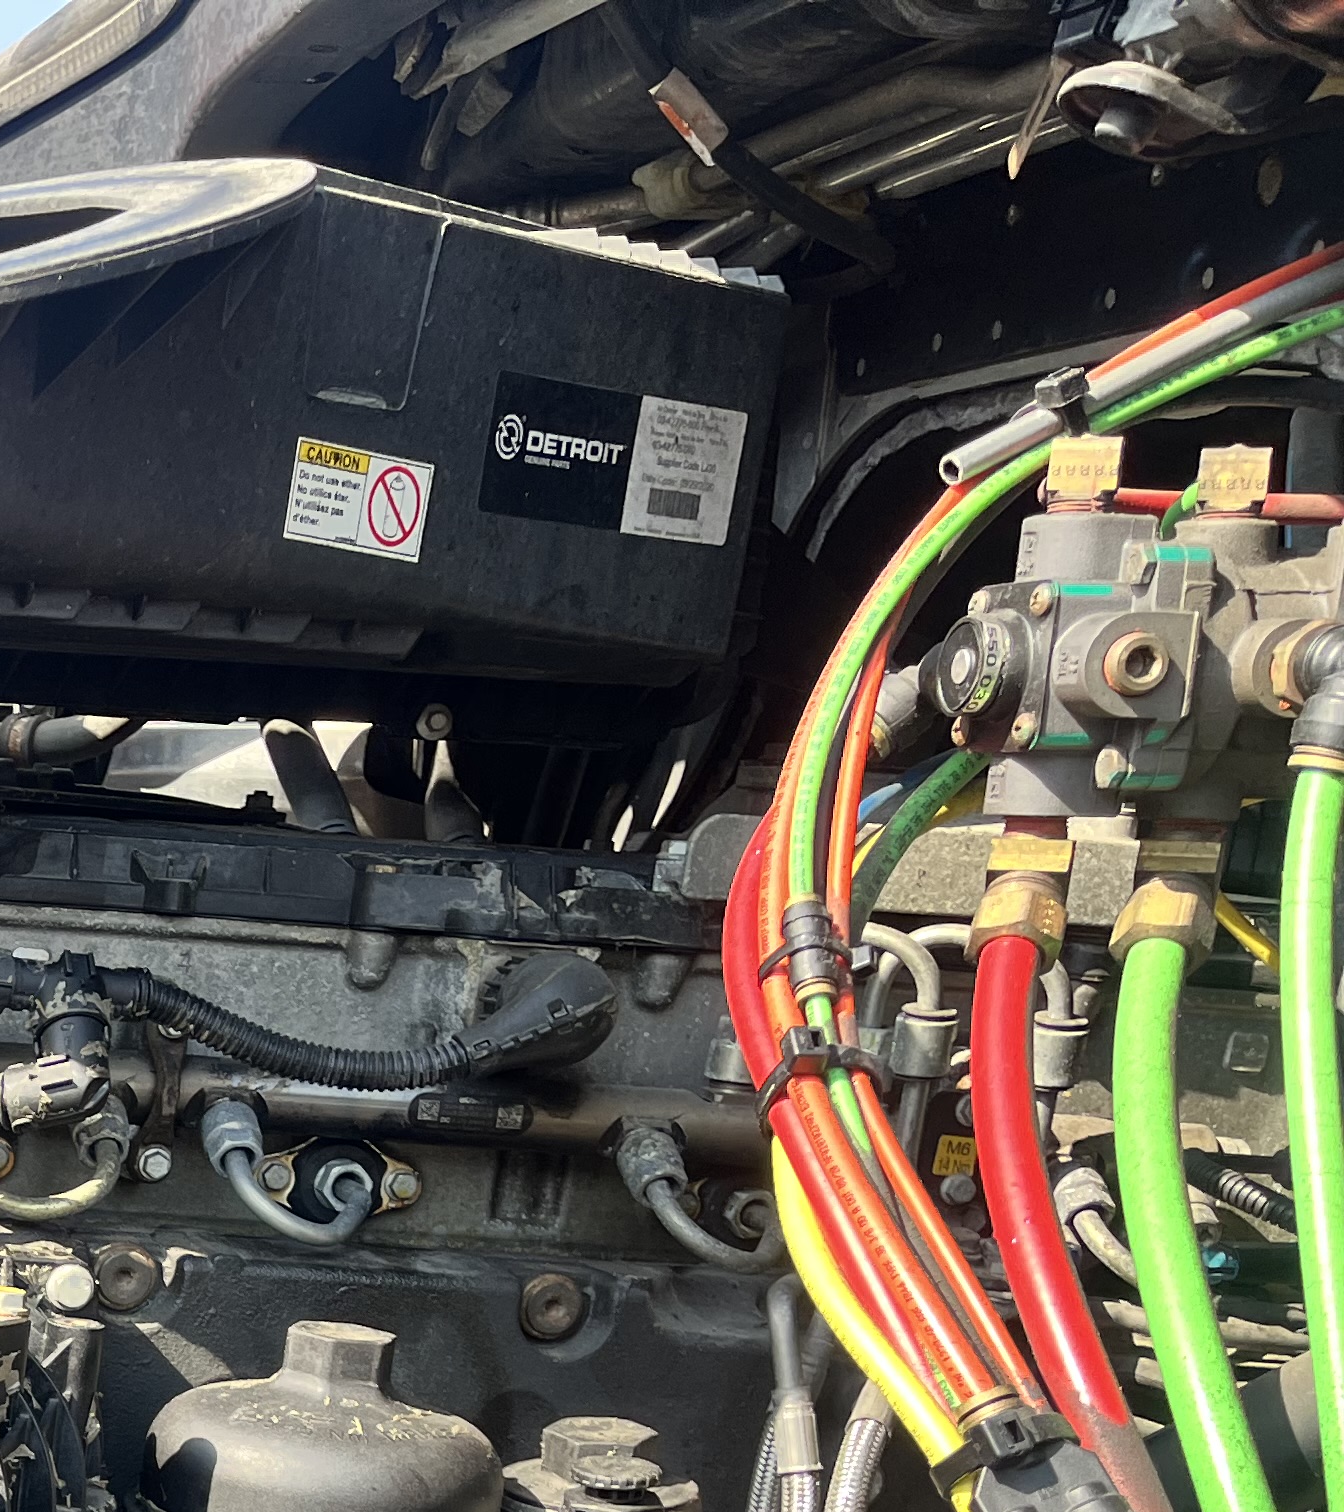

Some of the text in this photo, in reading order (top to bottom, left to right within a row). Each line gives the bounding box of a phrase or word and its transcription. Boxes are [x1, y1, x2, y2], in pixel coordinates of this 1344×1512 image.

[526, 430, 624, 465] DETROIT
[306, 446, 361, 471] CAUTION
[299, 469, 310, 480] Do
[311, 472, 325, 482] not
[297, 483, 308, 495] No
[966, 627, 998, 711] 550 030
[947, 1140, 972, 1155] M6
